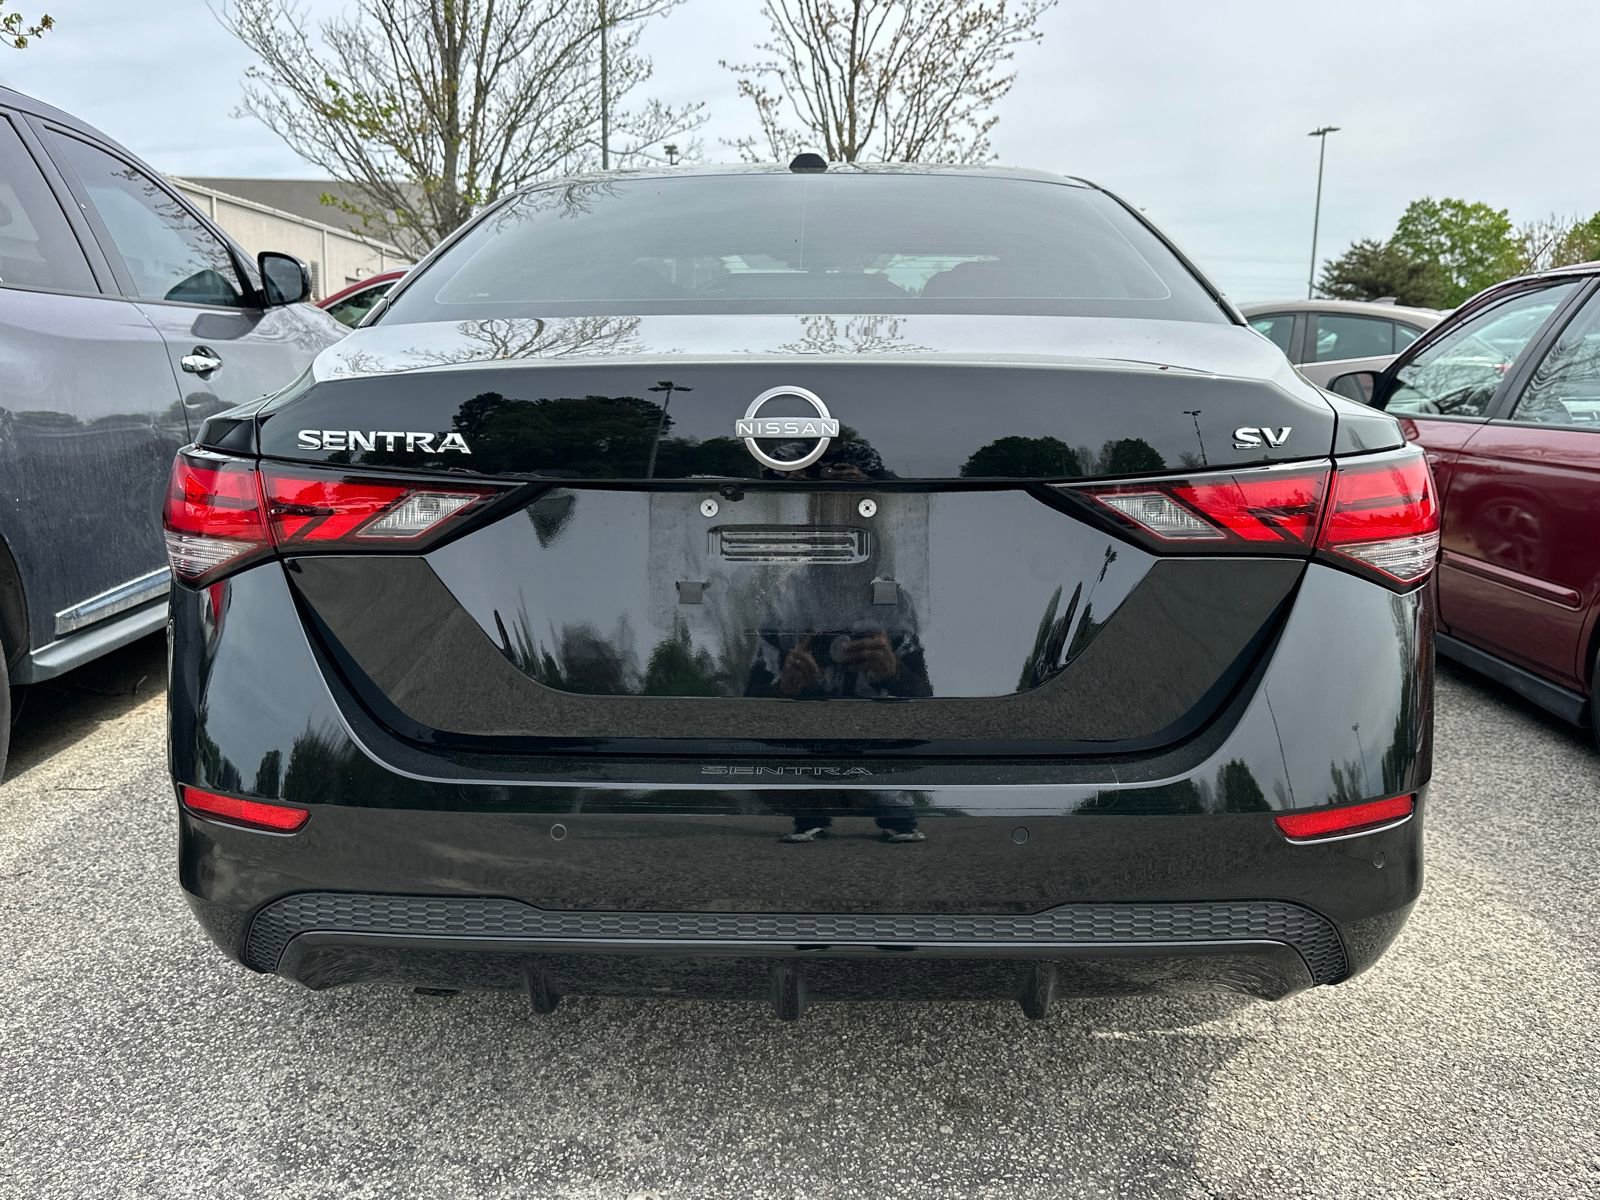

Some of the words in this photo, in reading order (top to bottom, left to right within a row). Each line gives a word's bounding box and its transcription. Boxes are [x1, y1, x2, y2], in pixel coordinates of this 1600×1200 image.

[738, 422, 836, 435] NISSAN
[1233, 426, 1292, 449] SV
[298, 429, 472, 455] SENTRA
[701, 765, 873, 776] SENTRA
